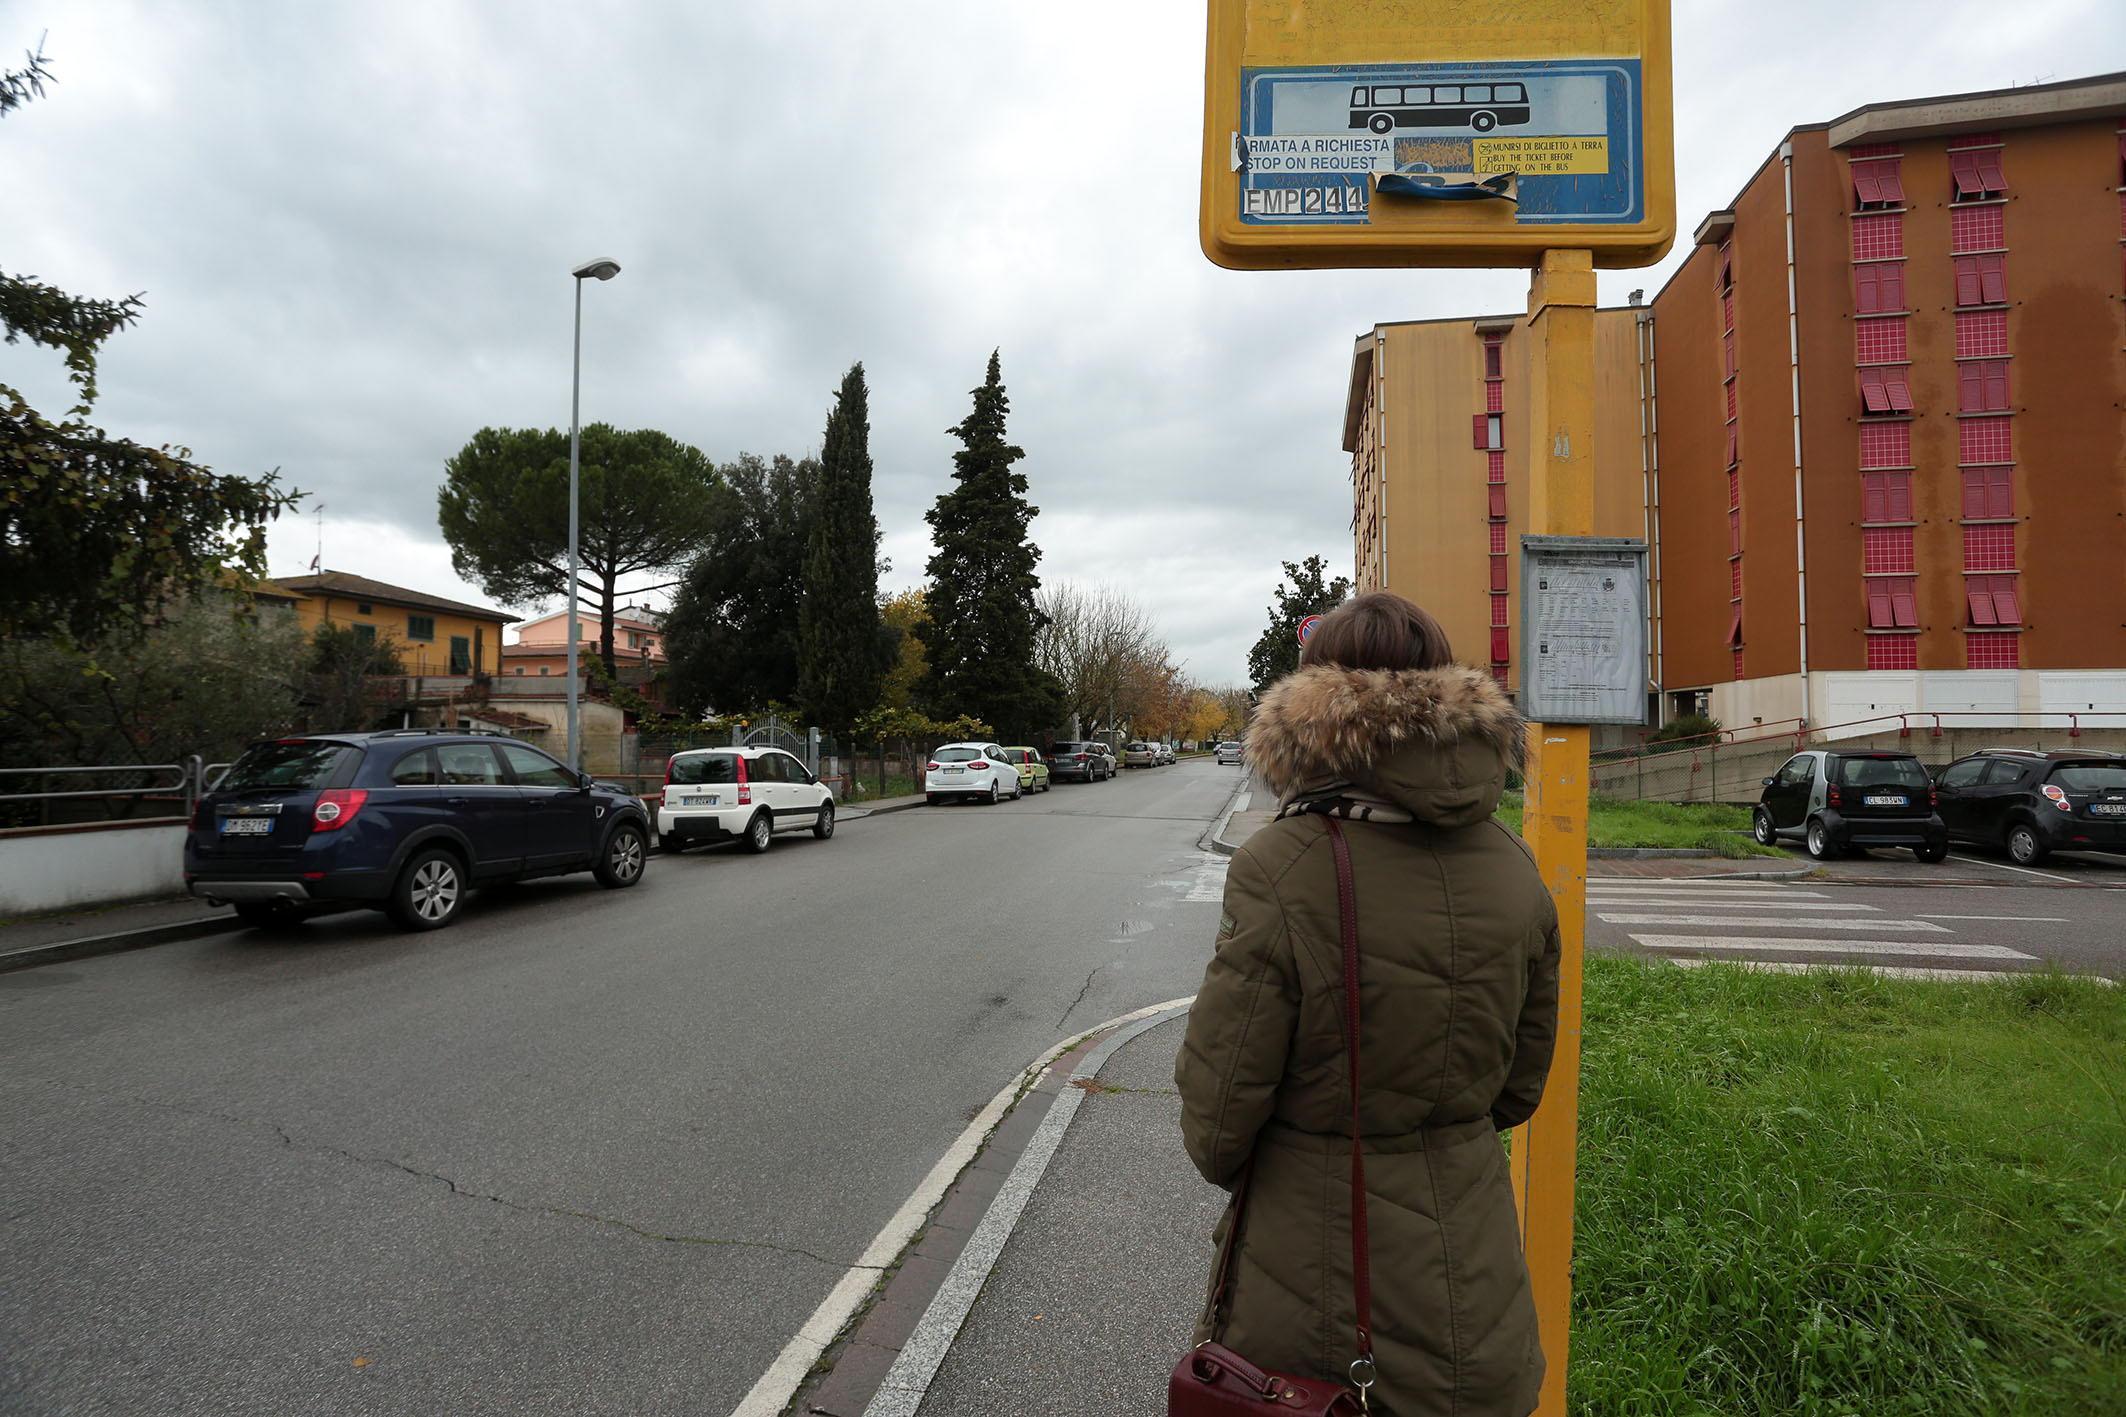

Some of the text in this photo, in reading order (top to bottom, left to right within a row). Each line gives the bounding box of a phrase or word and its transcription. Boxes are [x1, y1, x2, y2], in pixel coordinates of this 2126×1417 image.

[1301, 139, 1311, 152] A
[1315, 139, 1390, 152] RICHIESTA
[1493, 142, 1603, 151] MUNIRSI DI BIGLIETTO A TERRA
[1493, 153, 1573, 162] BUY THE TICKET BEFORE
[1247, 157, 1377, 169] STOP ON REQUEST
[1493, 163, 1569, 172] GETTING ON THE BUS
